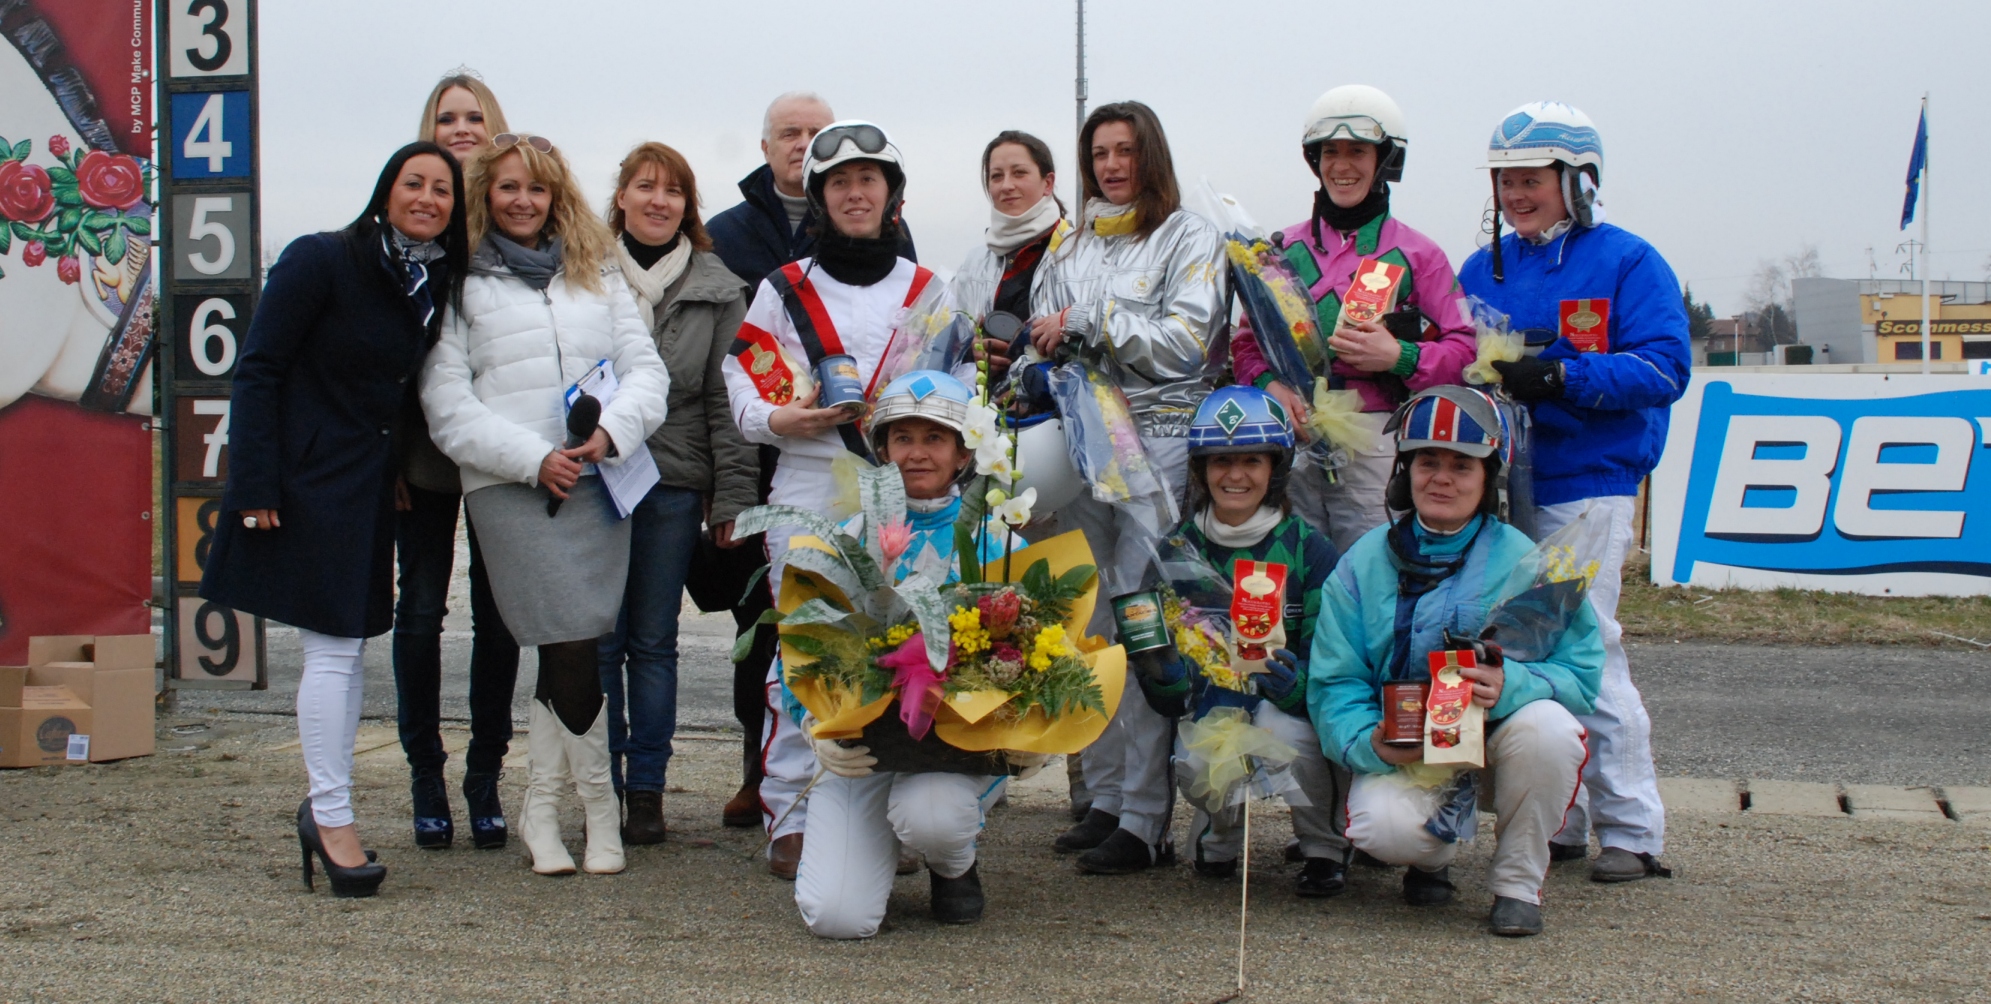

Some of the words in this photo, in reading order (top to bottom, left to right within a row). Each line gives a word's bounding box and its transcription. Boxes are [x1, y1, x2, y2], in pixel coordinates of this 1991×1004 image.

[131, 50, 142, 83] Make
[186, 0, 232, 71] 3
[131, 86, 142, 116] MCP
[131, 119, 143, 134] by
[184, 94, 233, 173] 4
[188, 197, 236, 276] 5
[189, 297, 238, 377] 6
[193, 399, 231, 478] 7
[195, 600, 240, 677] 9
